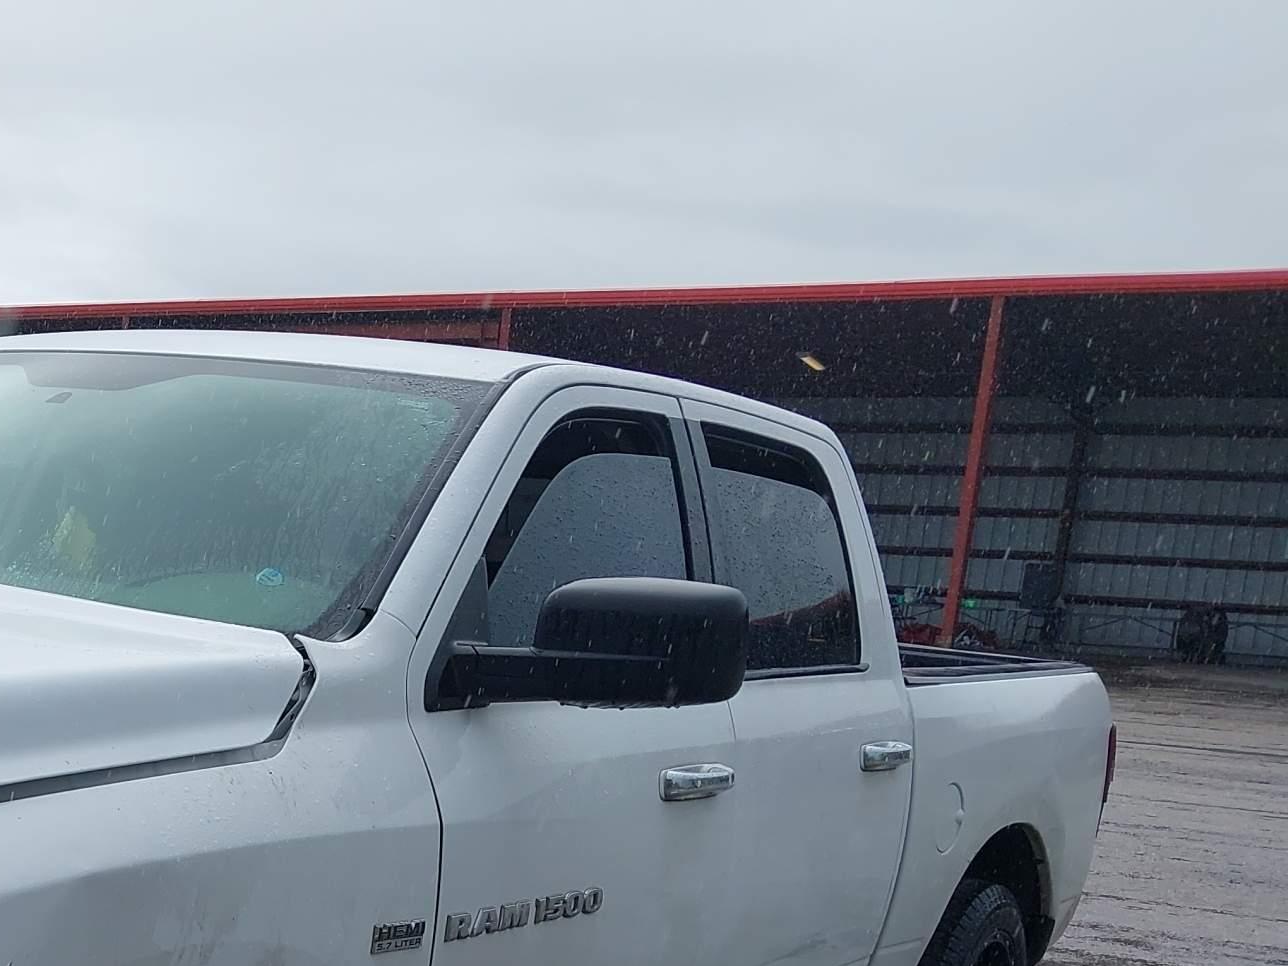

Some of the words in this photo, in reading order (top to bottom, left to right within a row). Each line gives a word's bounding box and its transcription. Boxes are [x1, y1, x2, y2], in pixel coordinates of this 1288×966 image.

[444, 901, 531, 942] RAM
[534, 887, 604, 925] 1500
[373, 920, 425, 941] HEMI
[376, 942, 392, 951] 5.7
[394, 938, 422, 949] LITER
